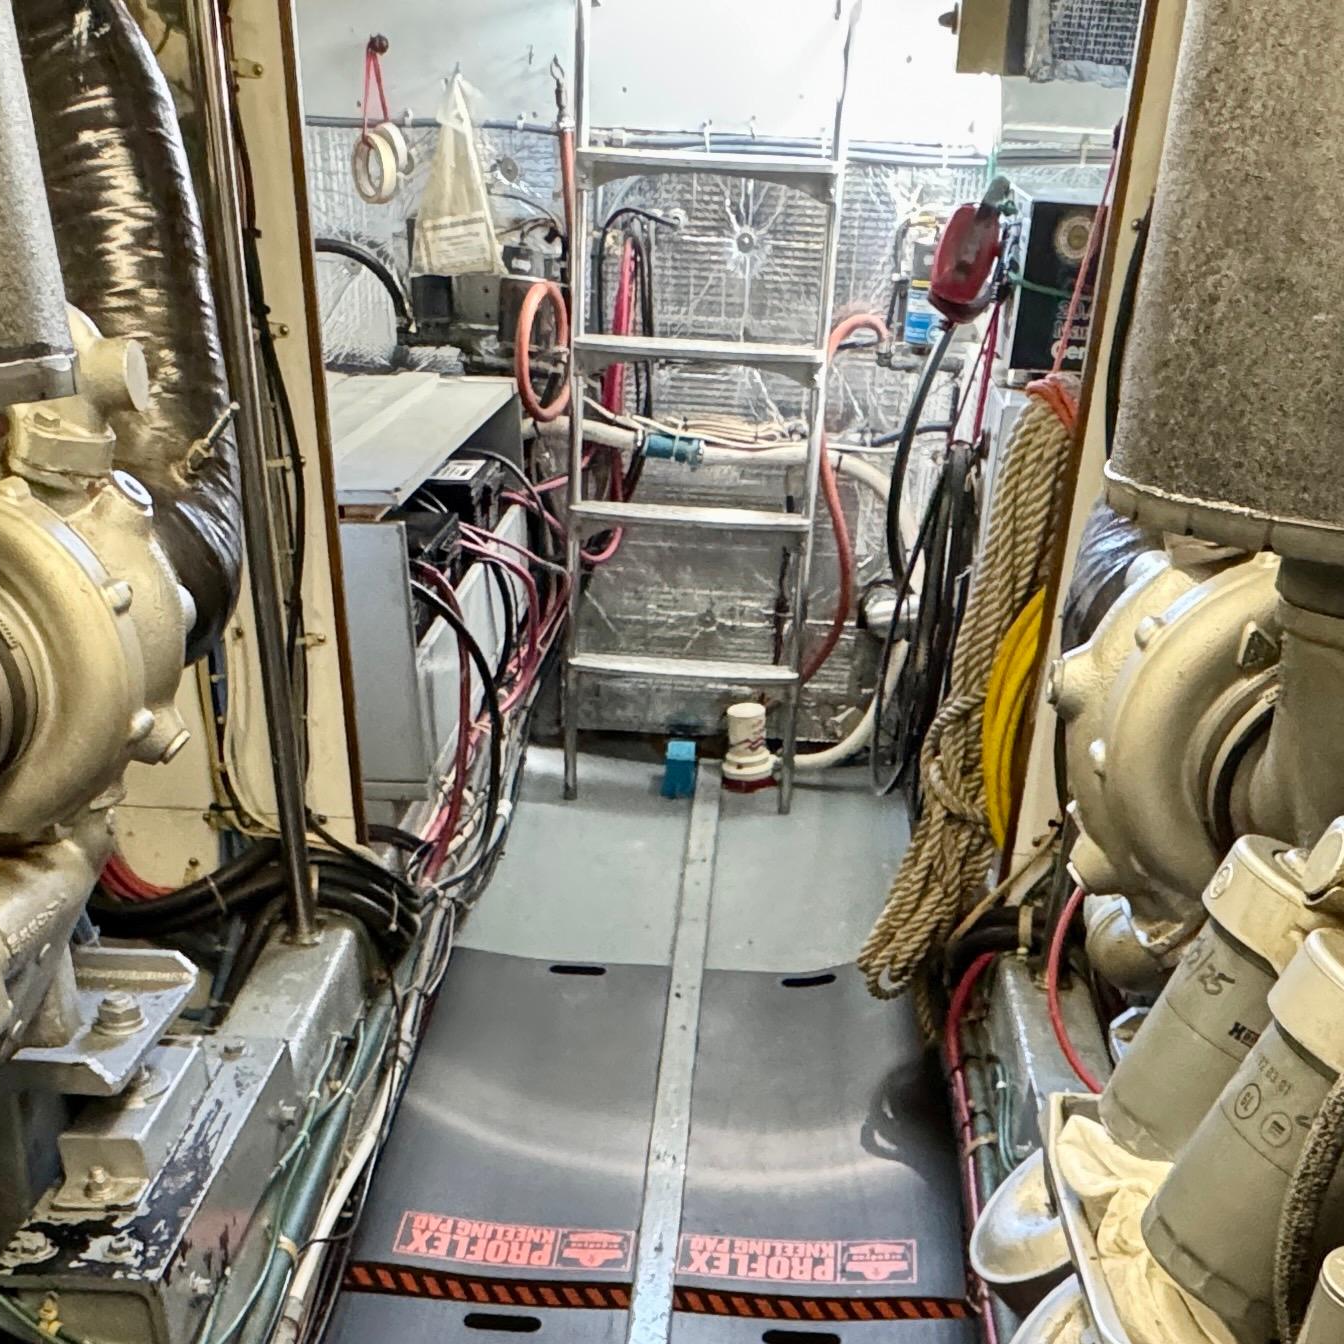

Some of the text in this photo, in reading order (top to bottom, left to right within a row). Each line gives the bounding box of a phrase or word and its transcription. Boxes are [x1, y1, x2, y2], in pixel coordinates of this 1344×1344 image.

[456, 1218, 555, 1243] KNEELING
[406, 1229, 553, 1266] PROFLEX
[734, 1239, 834, 1258] KNEELING
[688, 1251, 834, 1282] PROFLEX
